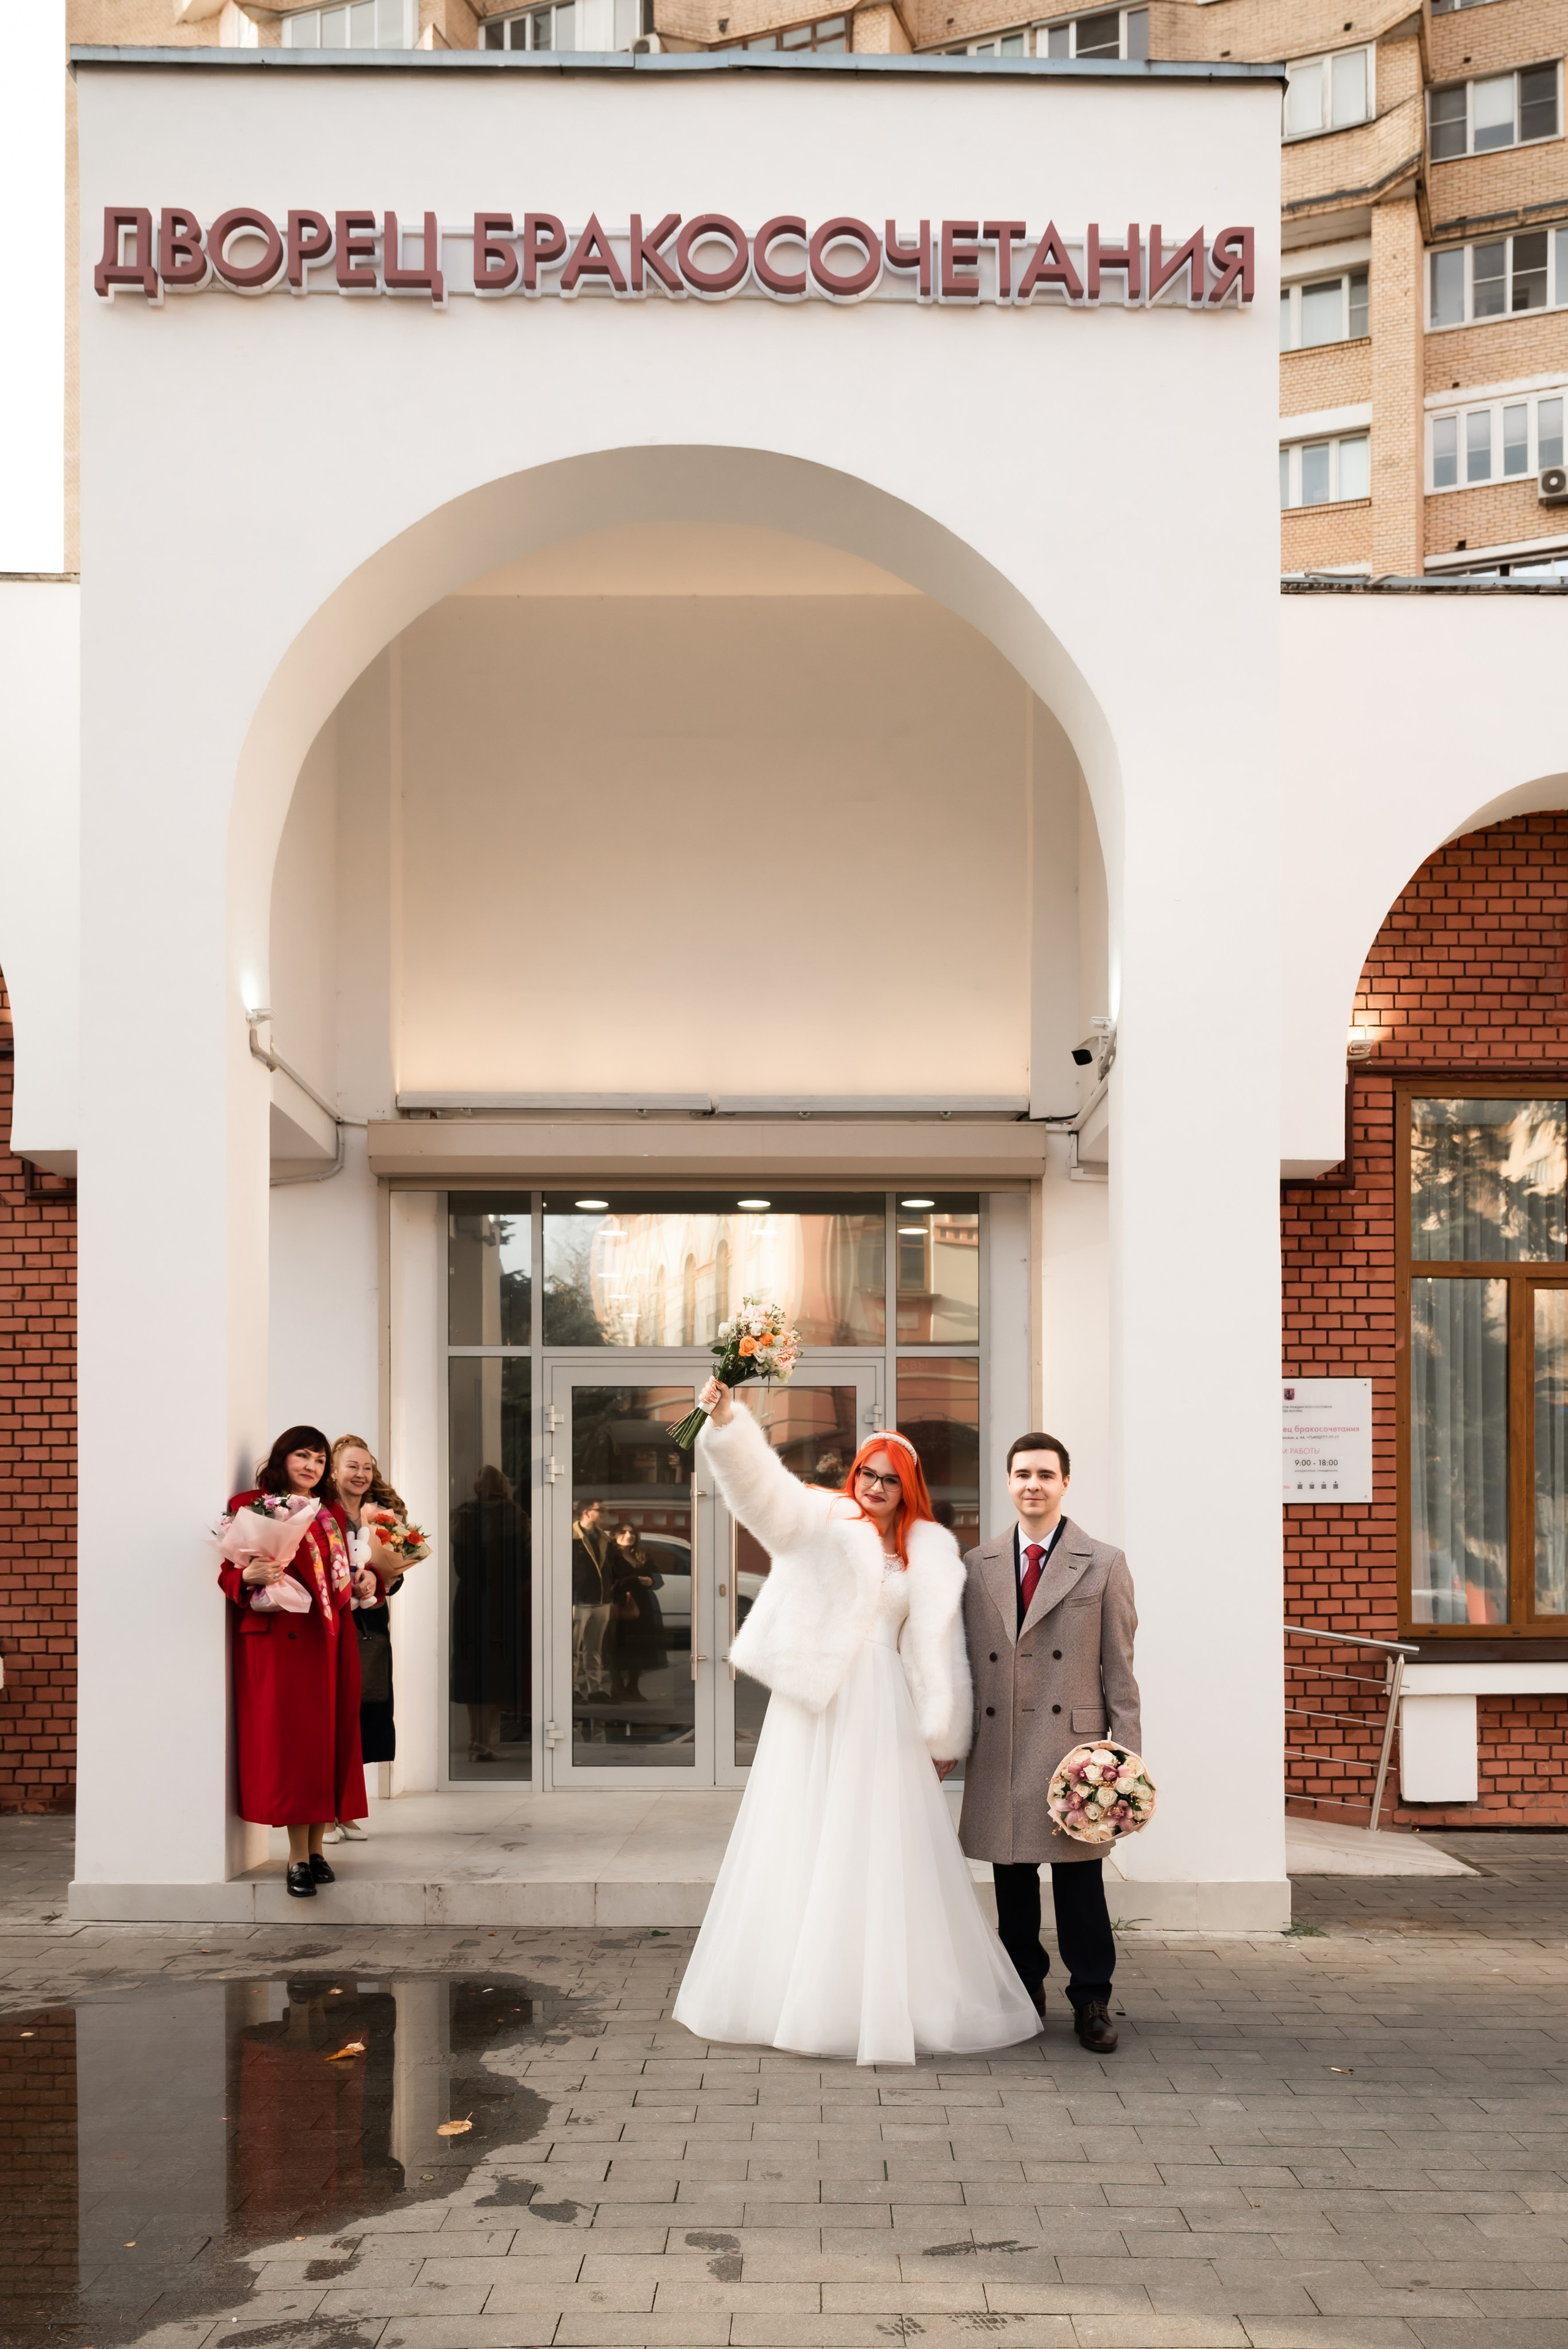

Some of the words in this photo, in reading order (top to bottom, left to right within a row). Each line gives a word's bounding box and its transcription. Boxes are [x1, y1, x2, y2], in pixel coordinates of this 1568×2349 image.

[95, 208, 443, 300] ДВОРЕЦ
[473, 213, 1254, 300] БРАКОСОЧЕТАНИЯ
[1294, 1424, 1360, 1434] бракосочетания
